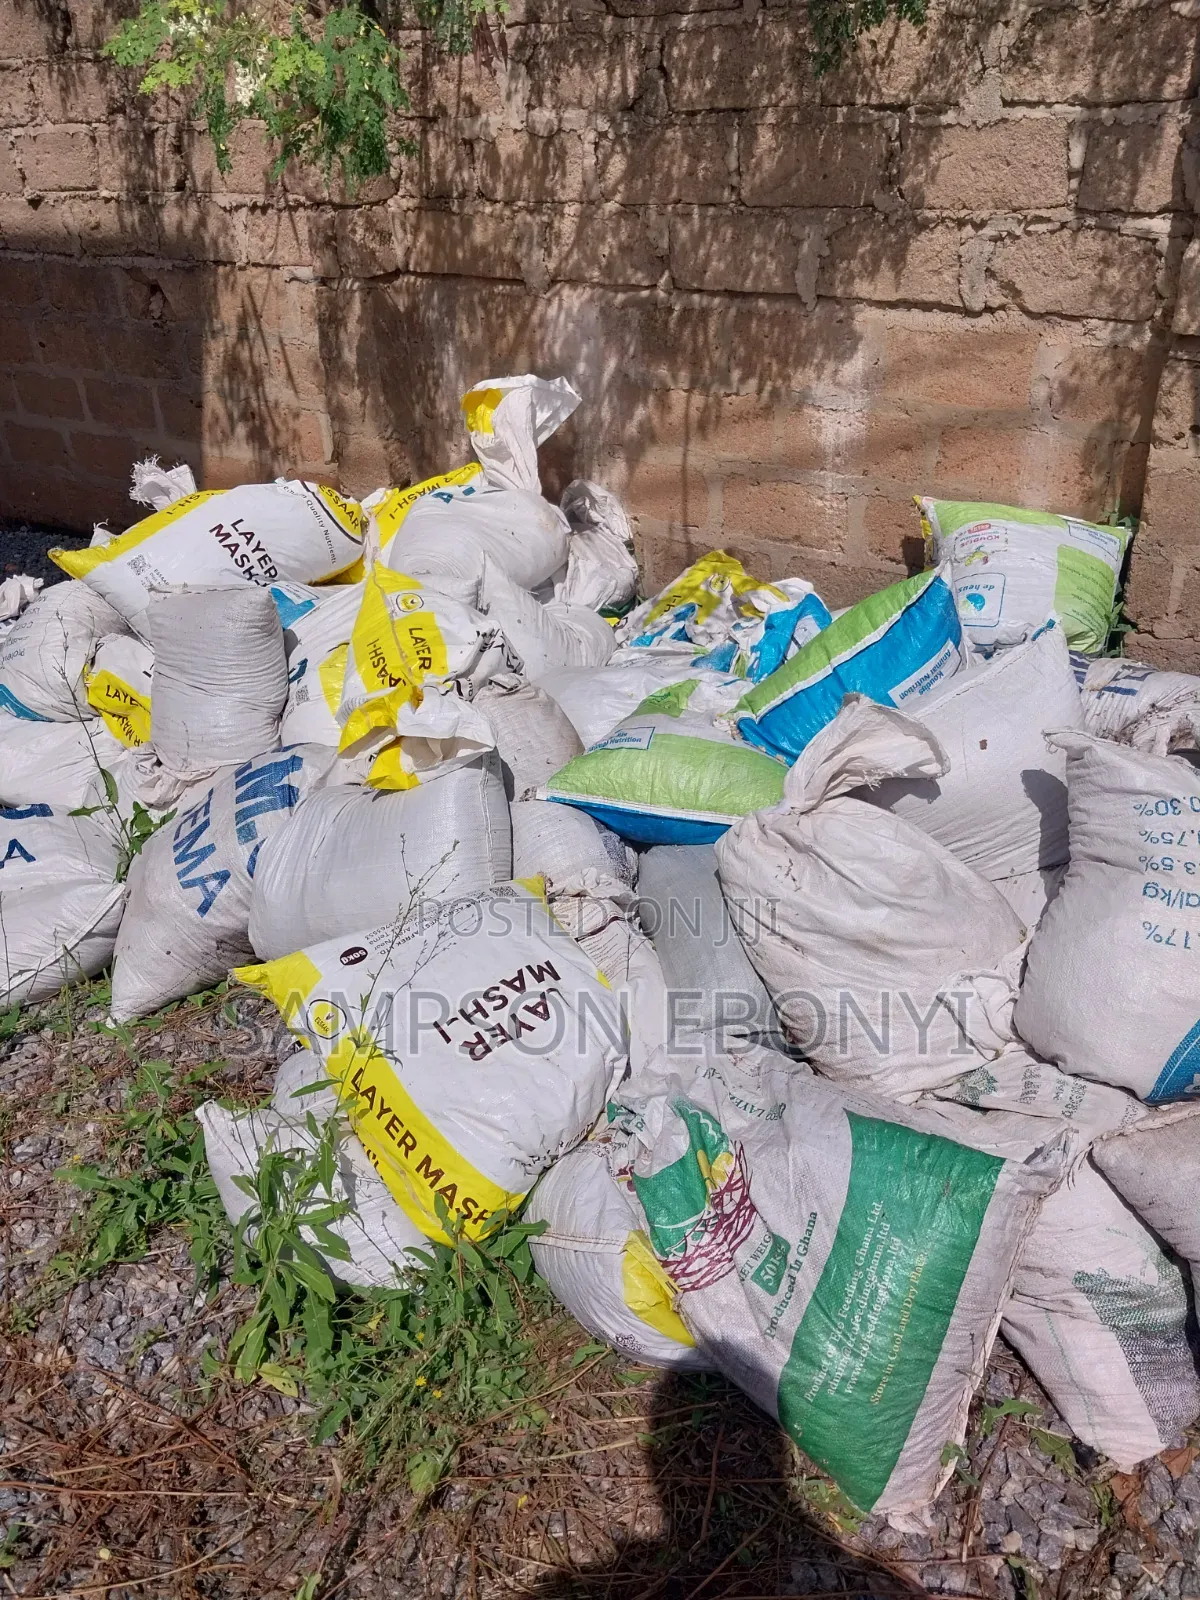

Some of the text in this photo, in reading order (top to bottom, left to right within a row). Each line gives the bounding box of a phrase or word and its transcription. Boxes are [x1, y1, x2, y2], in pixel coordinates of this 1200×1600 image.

[230, 518, 278, 581] LAYER
[306, 499, 336, 564] Quality Nutrients
[408, 626, 432, 670] LAYER
[899, 650, 951, 700] Animal Nutrition
[173, 788, 231, 918] TEMA
[433, 960, 562, 1044] MASH-I
[351, 1067, 417, 1160] LAYER
[765, 1211, 818, 1339] Produced In Ghana
[803, 1360, 831, 1402] Product
[838, 1269, 864, 1318] Feeding
[854, 1226, 875, 1266] Ghana
[867, 1198, 884, 1223] Ltd.
[869, 1376, 889, 1404] Store
[887, 1332, 903, 1360] Cool
[897, 1309, 910, 1331] and
[904, 1285, 919, 1308] Dry
